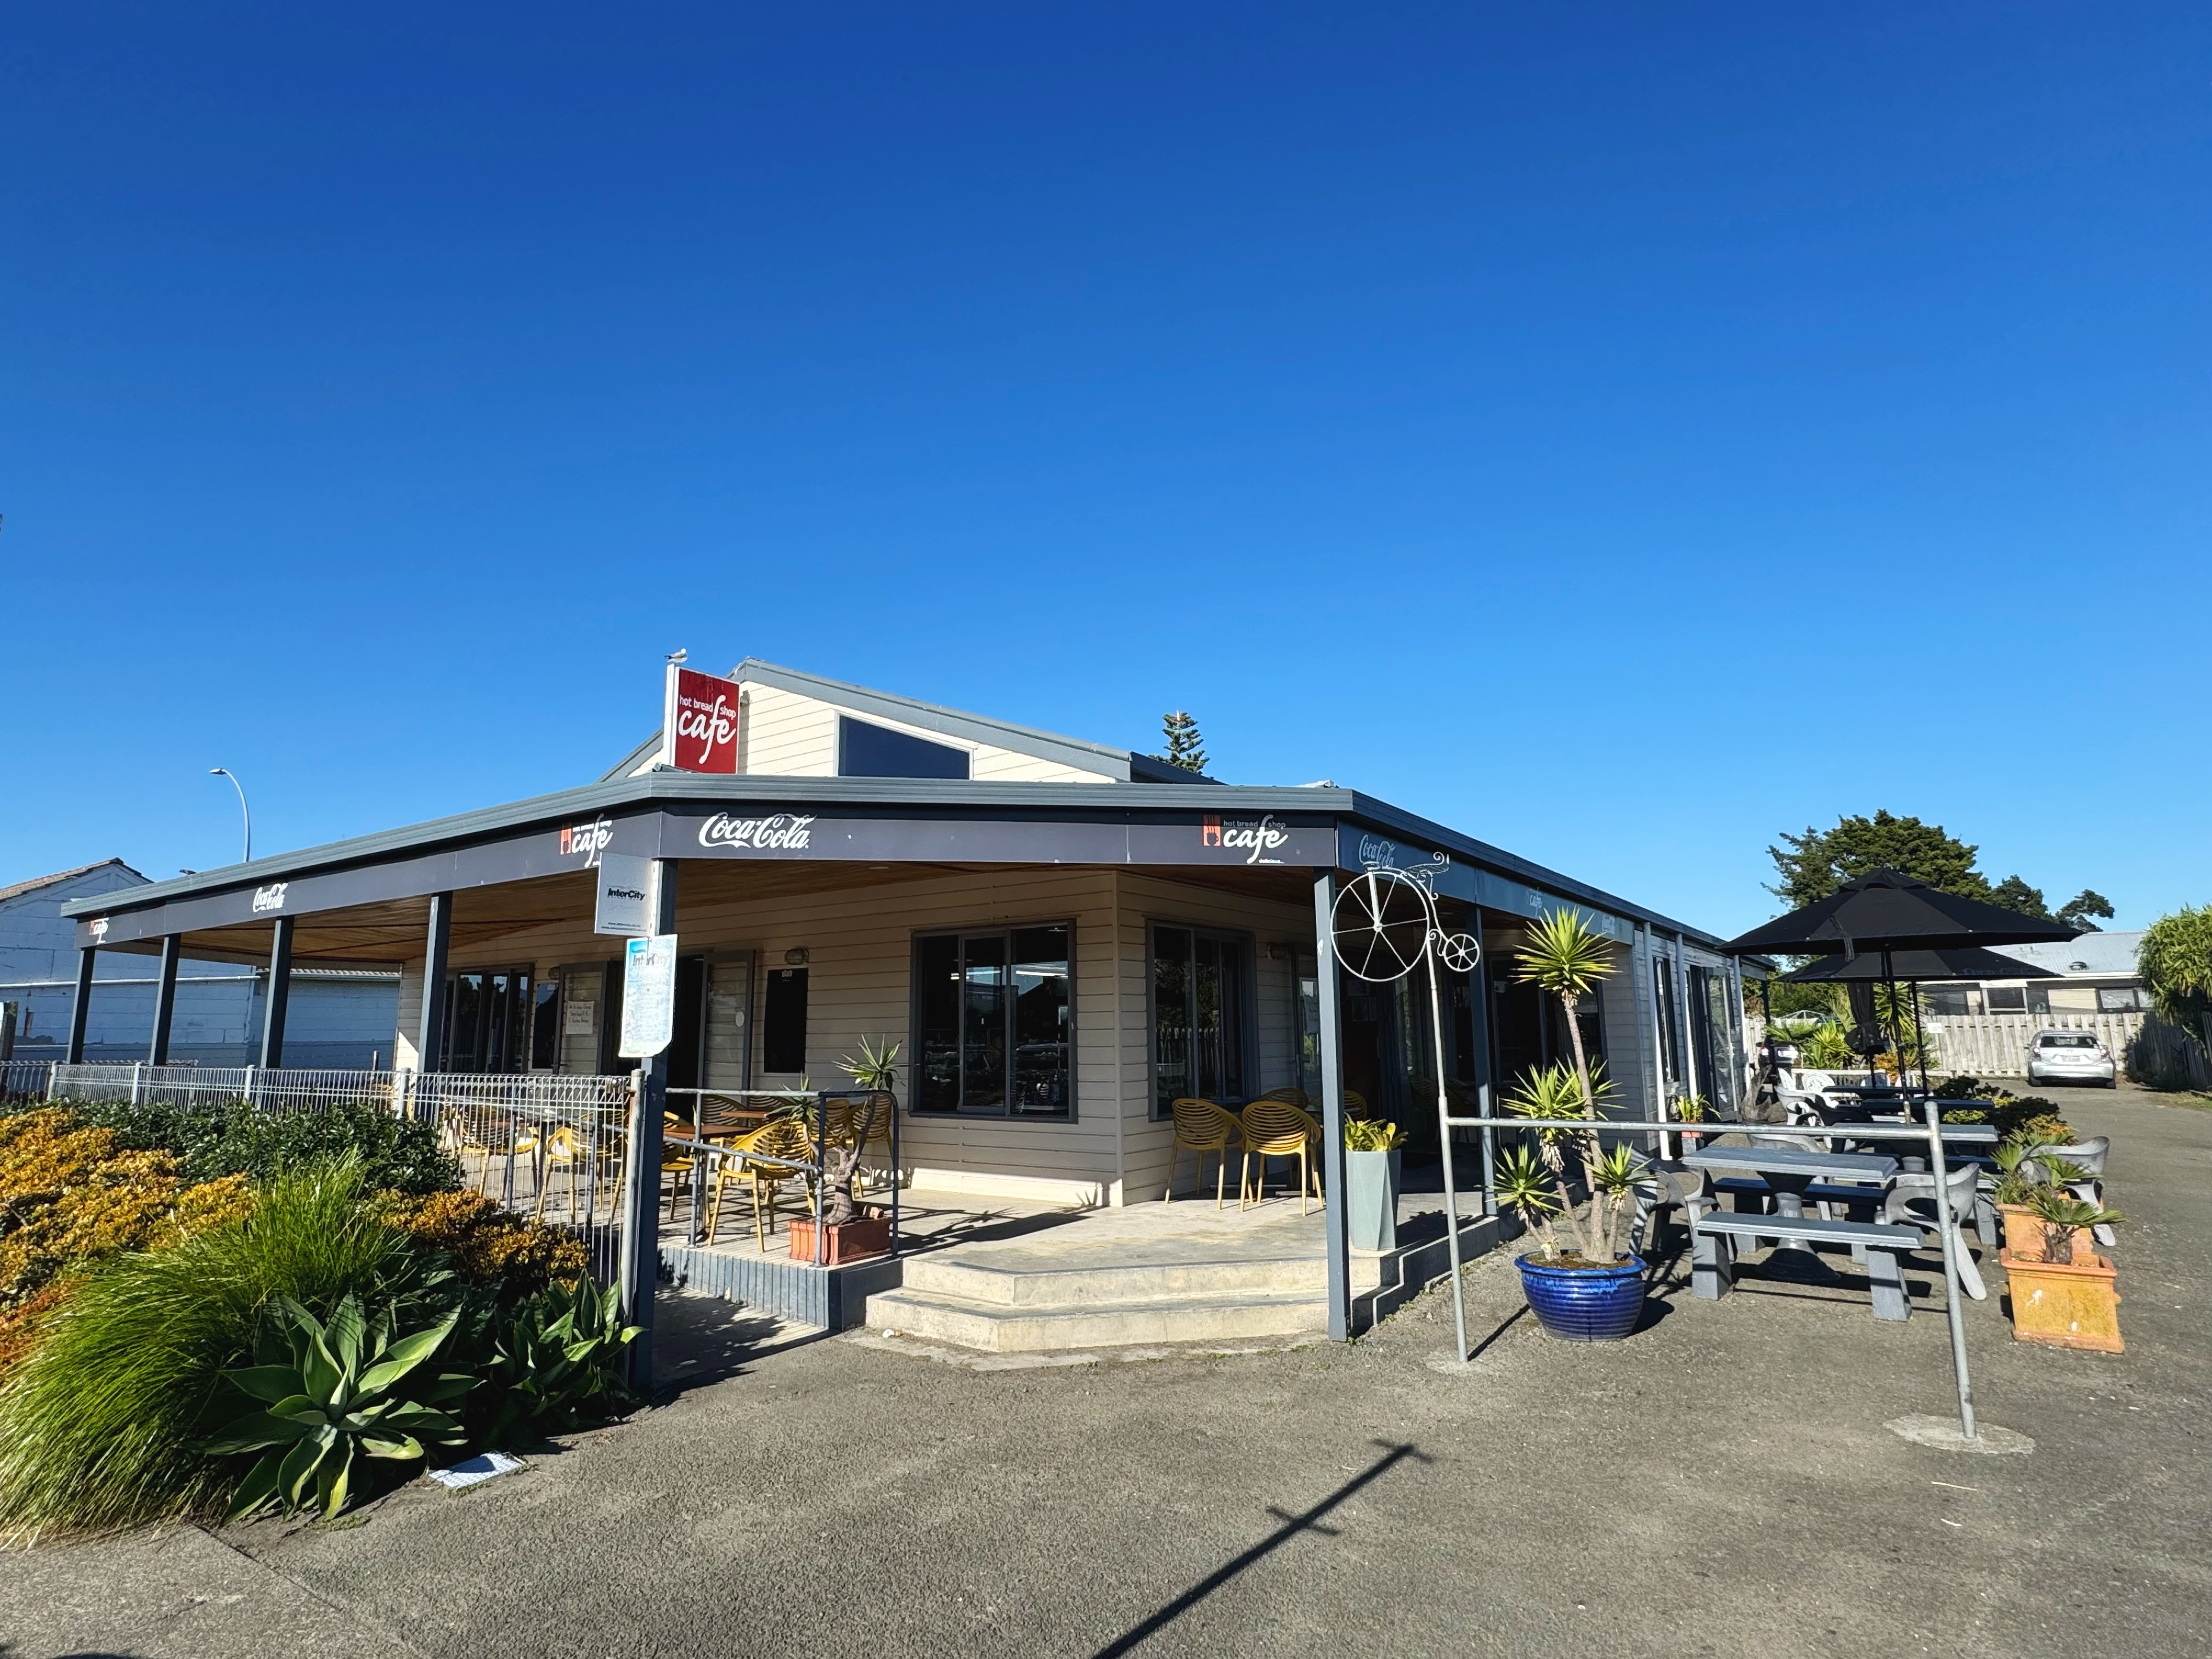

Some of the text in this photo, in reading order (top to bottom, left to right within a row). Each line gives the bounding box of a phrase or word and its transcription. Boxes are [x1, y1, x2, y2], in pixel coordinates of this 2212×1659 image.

[680, 694, 736, 720] hot bread shop
[678, 695, 736, 764] cafe
[572, 813, 613, 868] cafe
[1223, 814, 1289, 864] cafe
[1268, 821, 1286, 830] shop
[607, 888, 645, 900] InterCity
